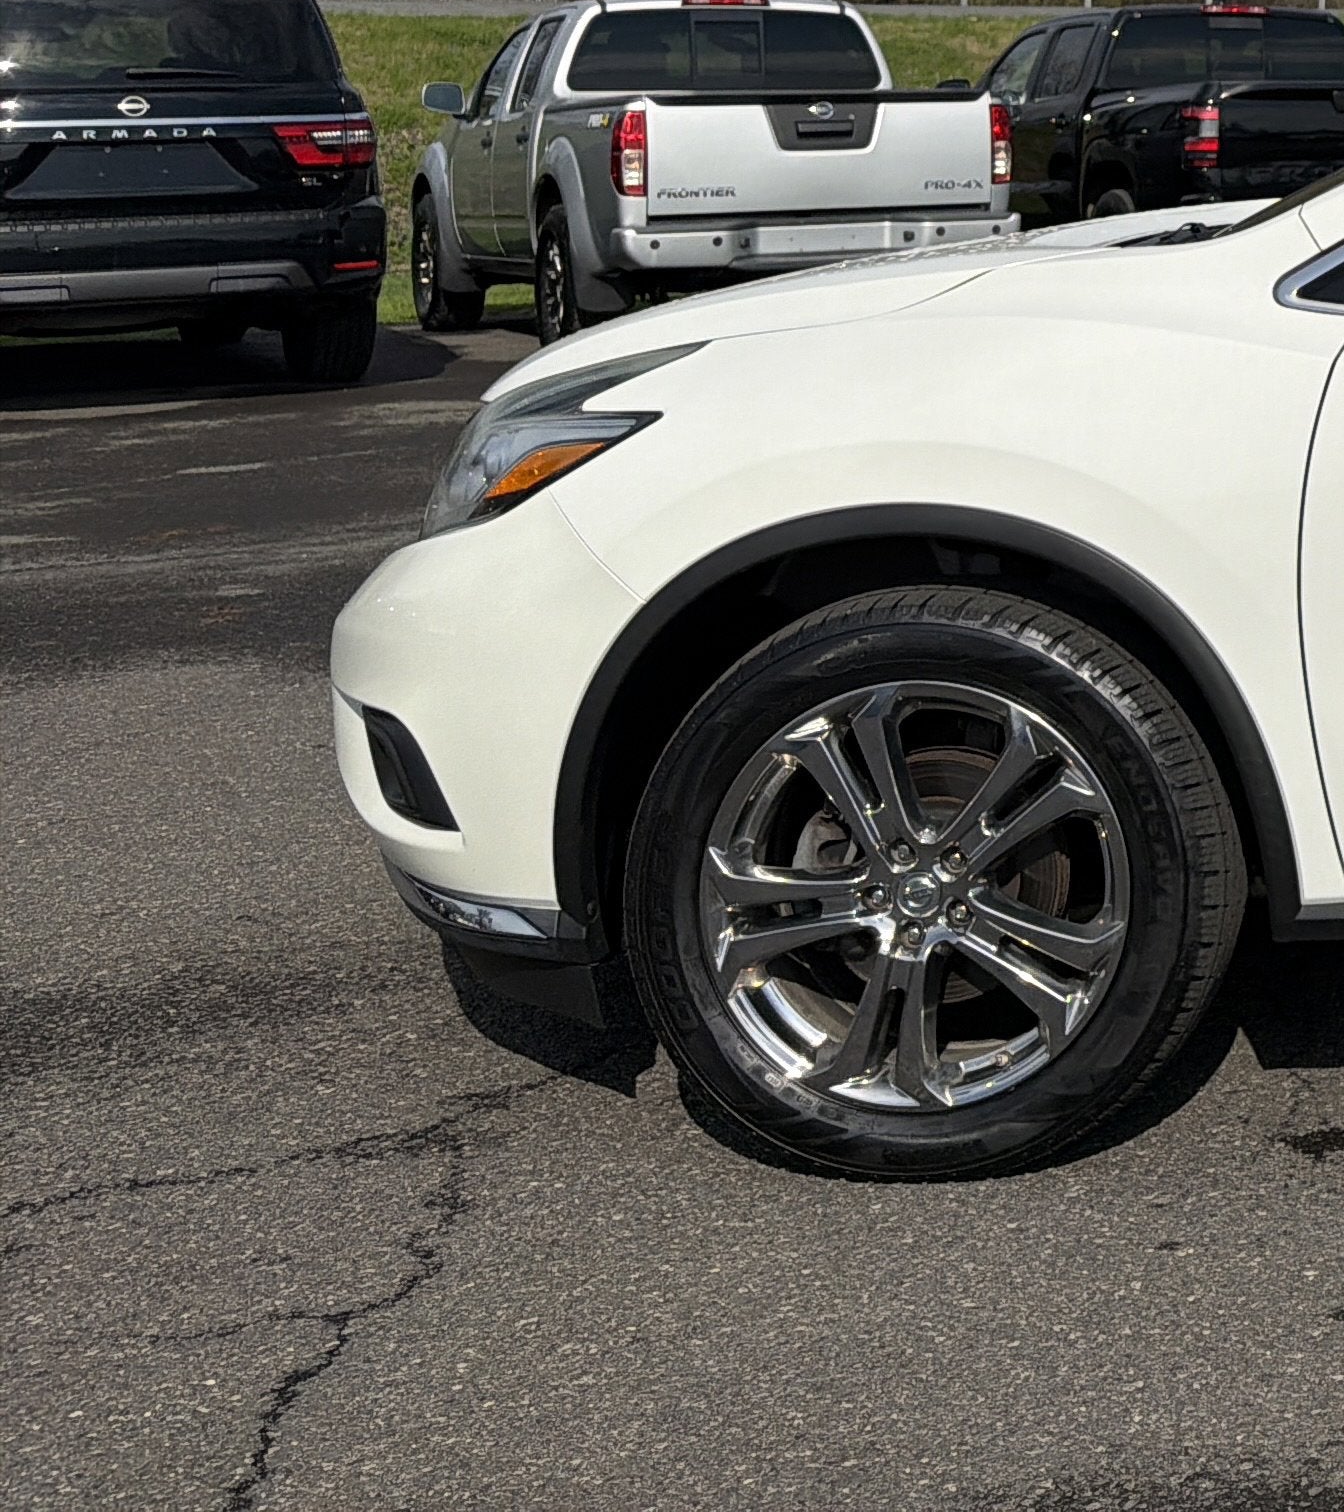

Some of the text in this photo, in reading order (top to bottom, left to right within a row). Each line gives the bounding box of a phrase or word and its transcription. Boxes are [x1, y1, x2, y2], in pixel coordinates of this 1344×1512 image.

[51, 127, 217, 140] ARMADA
[924, 179, 985, 190] PRO-4X
[656, 187, 737, 199] FRONTIER
